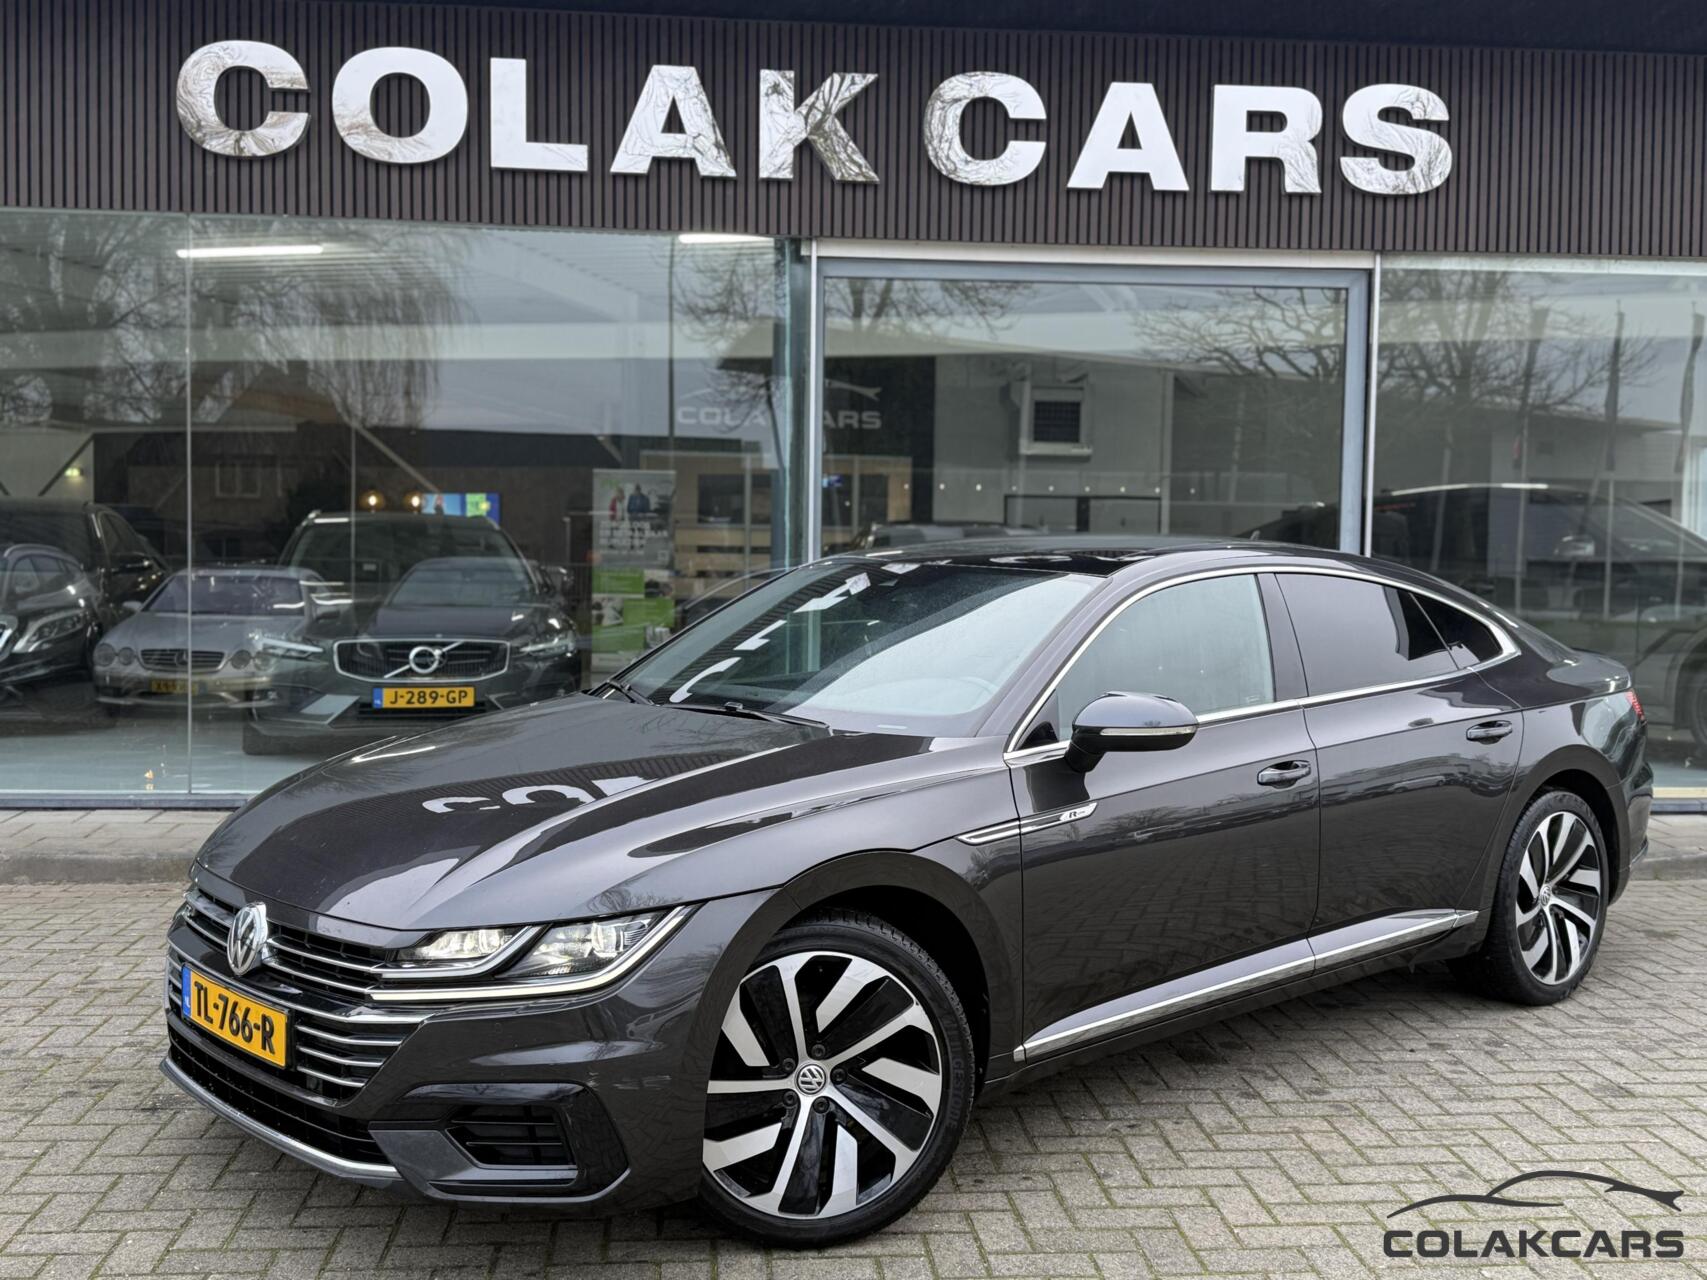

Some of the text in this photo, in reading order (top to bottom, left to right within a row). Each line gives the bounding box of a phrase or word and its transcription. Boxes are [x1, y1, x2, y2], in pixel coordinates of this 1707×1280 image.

[175, 40, 1453, 197] COLAK CARS
[389, 690, 468, 705] J-289-GP
[194, 981, 276, 1055] TL-766-R
